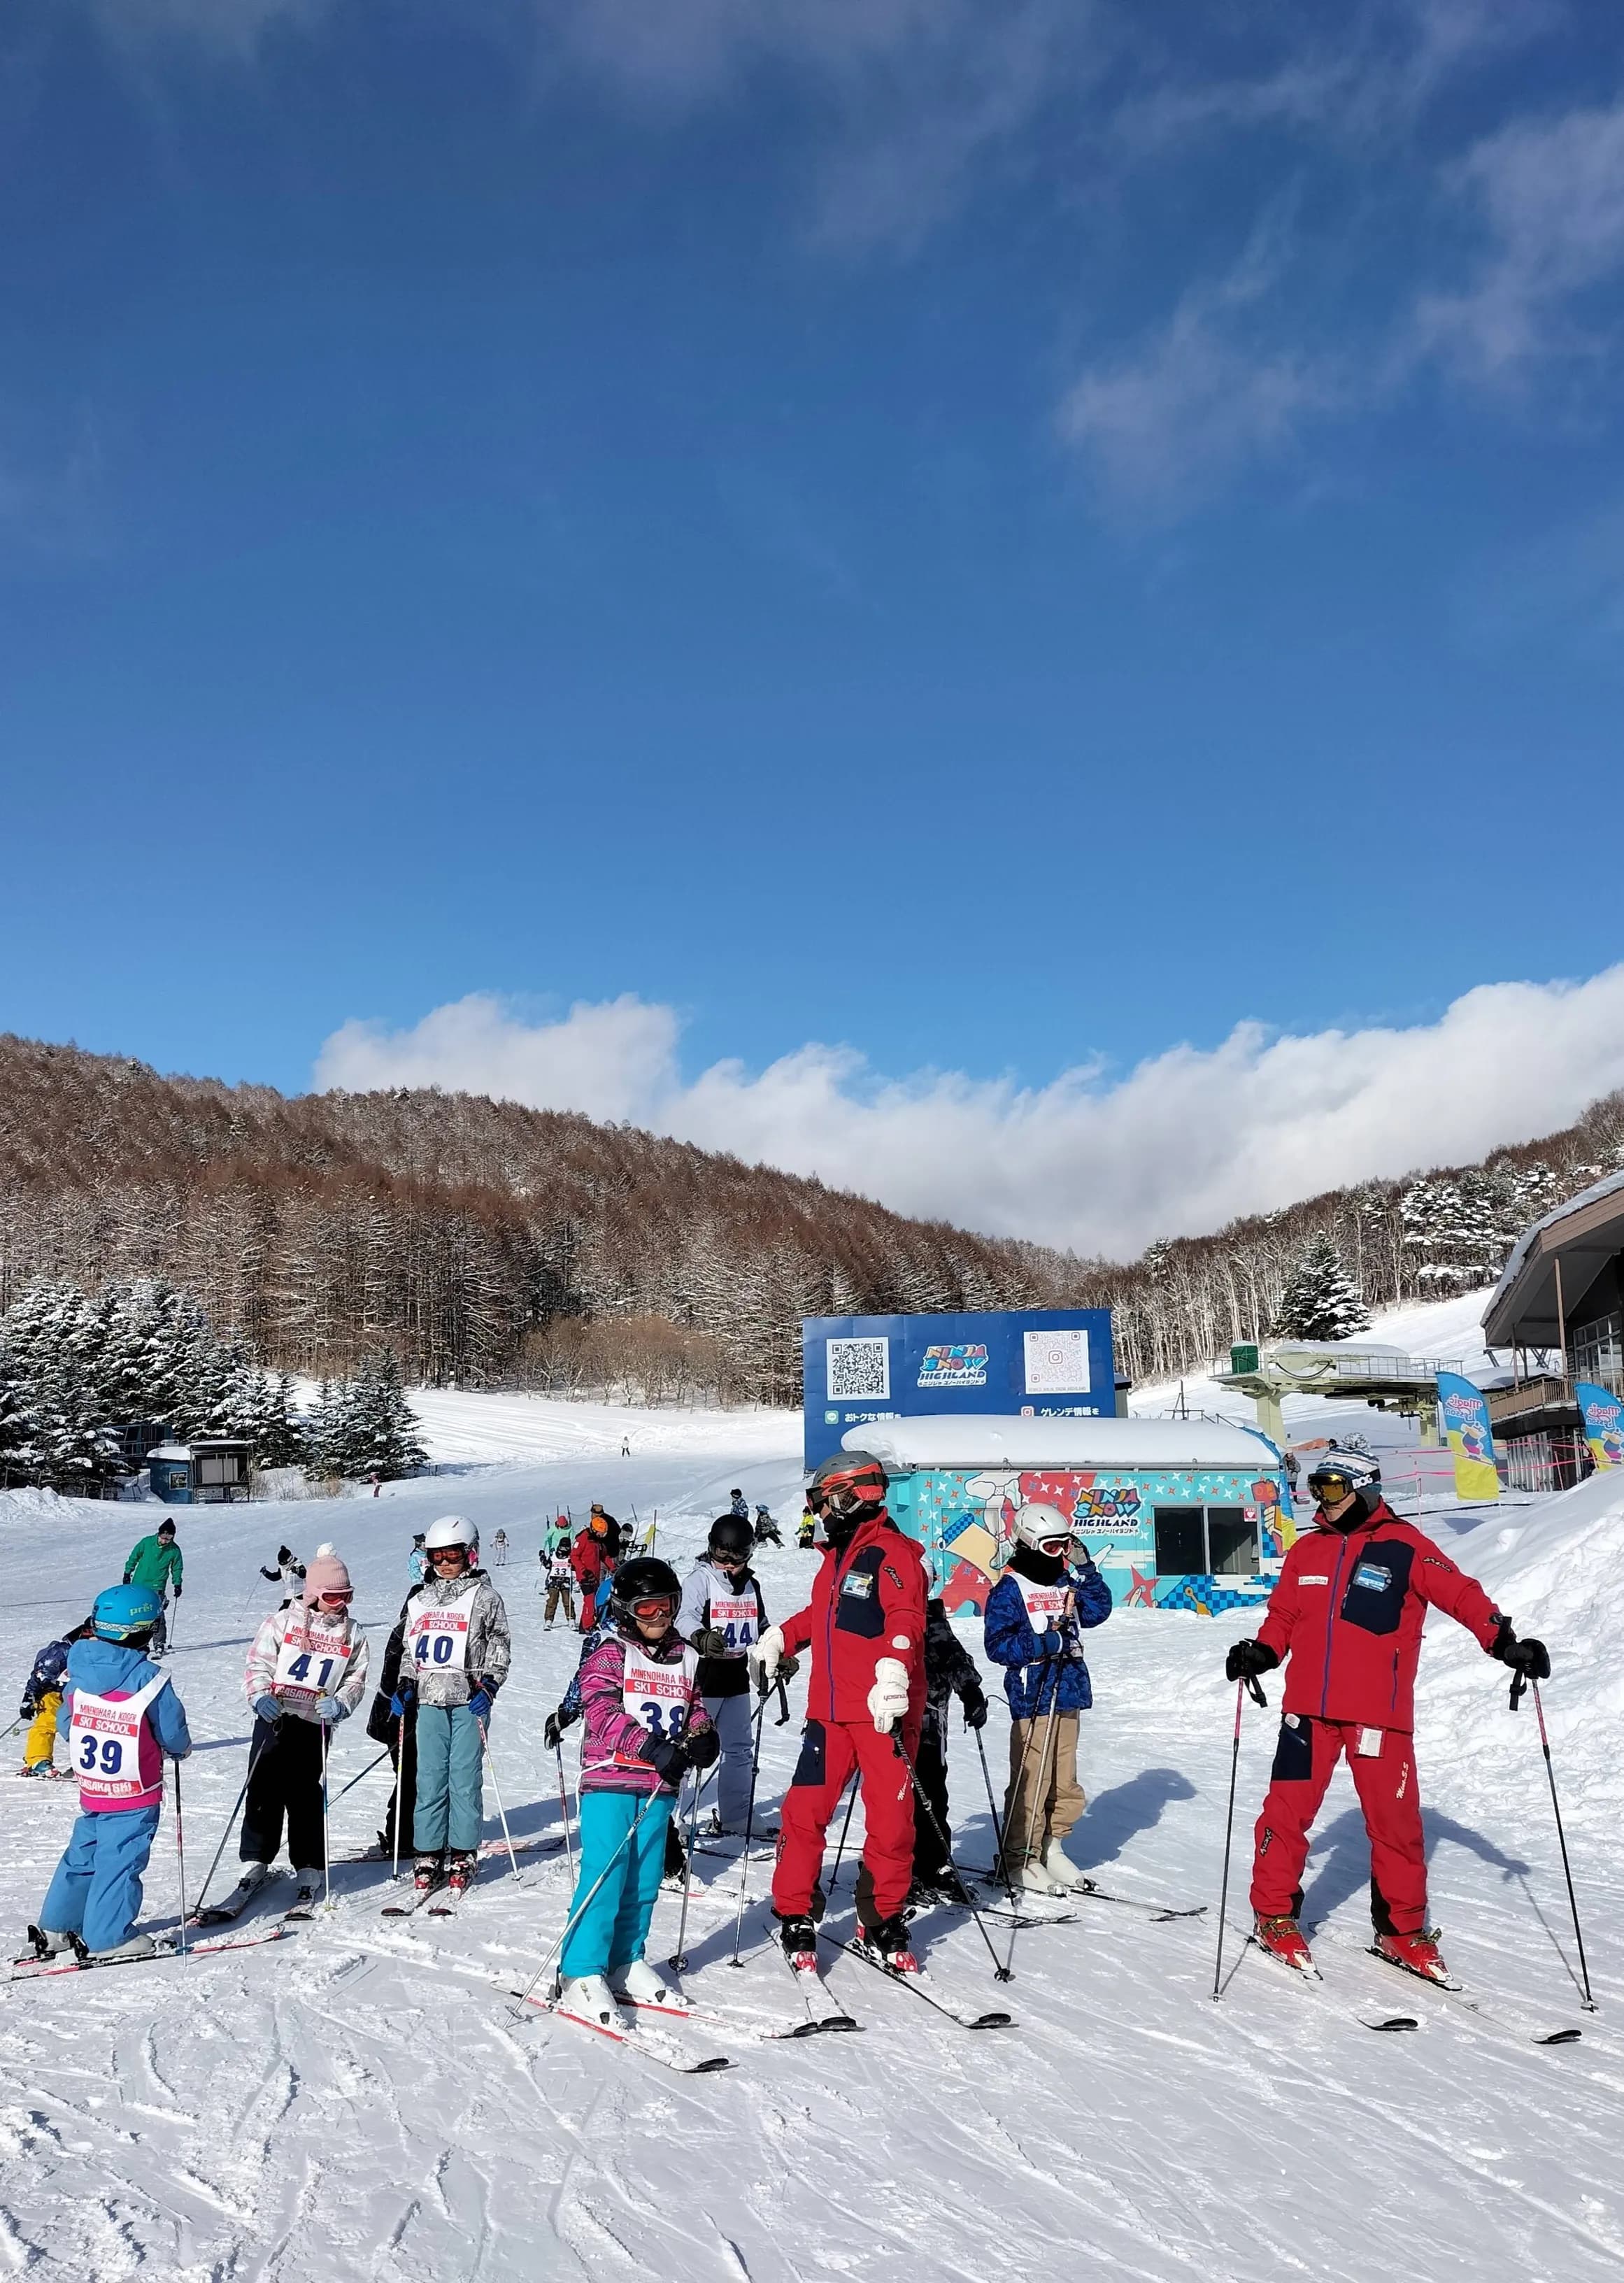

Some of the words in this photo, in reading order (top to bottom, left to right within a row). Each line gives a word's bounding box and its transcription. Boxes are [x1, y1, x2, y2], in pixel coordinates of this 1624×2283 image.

[927, 1346, 987, 1358] NINJA
[923, 1357, 987, 1372] SNOW
[920, 1372, 985, 1380] HIGHLAND
[1041, 1407, 1099, 1416] ゲレンデ情報を
[1077, 1488, 1141, 1504] NINJA
[1074, 1502, 1141, 1519] SNOW
[554, 1567, 567, 1576] 33
[732, 1609, 754, 1617] SCHOOL
[429, 1621, 460, 1630] SCHOOL
[723, 1622, 753, 1648] 44
[311, 1641, 343, 1655] SCHOOL
[415, 1635, 453, 1664] 40
[287, 1653, 334, 1688] 41
[631, 1667, 676, 1684] MINENOHARA
[634, 1681, 650, 1693] SKI
[80, 1704, 116, 1720] MINENOHARA
[640, 1702, 685, 1736] 38
[79, 1716, 93, 1726] SKI
[95, 1719, 131, 1735] SCHOOL
[80, 1735, 122, 1775] 39
